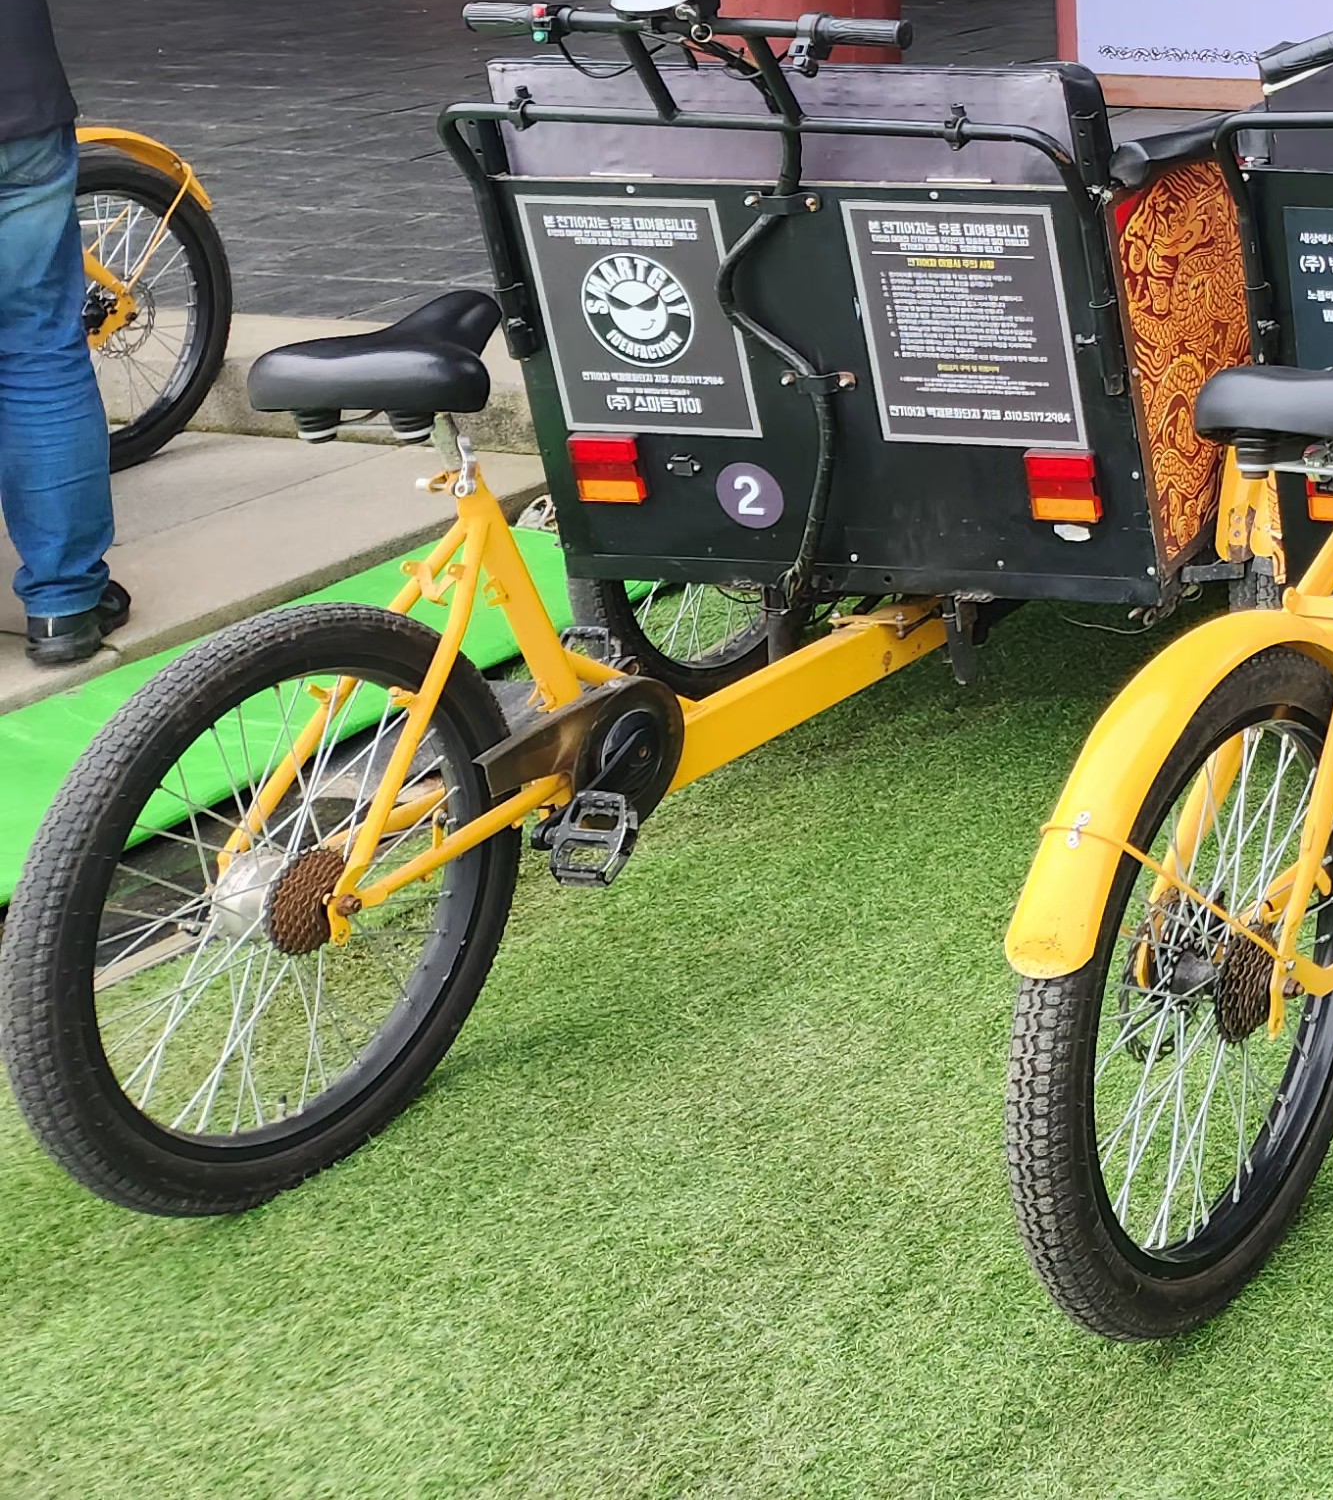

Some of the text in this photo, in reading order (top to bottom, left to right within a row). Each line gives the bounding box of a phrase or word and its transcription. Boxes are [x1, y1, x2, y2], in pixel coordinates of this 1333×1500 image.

[543, 215, 555, 229] 본
[609, 216, 632, 230] 유료
[632, 217, 696, 231] 대여용입니다
[868, 221, 1029, 238] 본 전기어차는 유료 대여용입니다
[1299, 255, 1325, 273] (주)
[585, 256, 690, 318] SMARTGUY
[605, 328, 683, 360] IDEAFACTORY
[606, 395, 702, 413] (주) 스마트가이
[733, 475, 766, 516] 2
